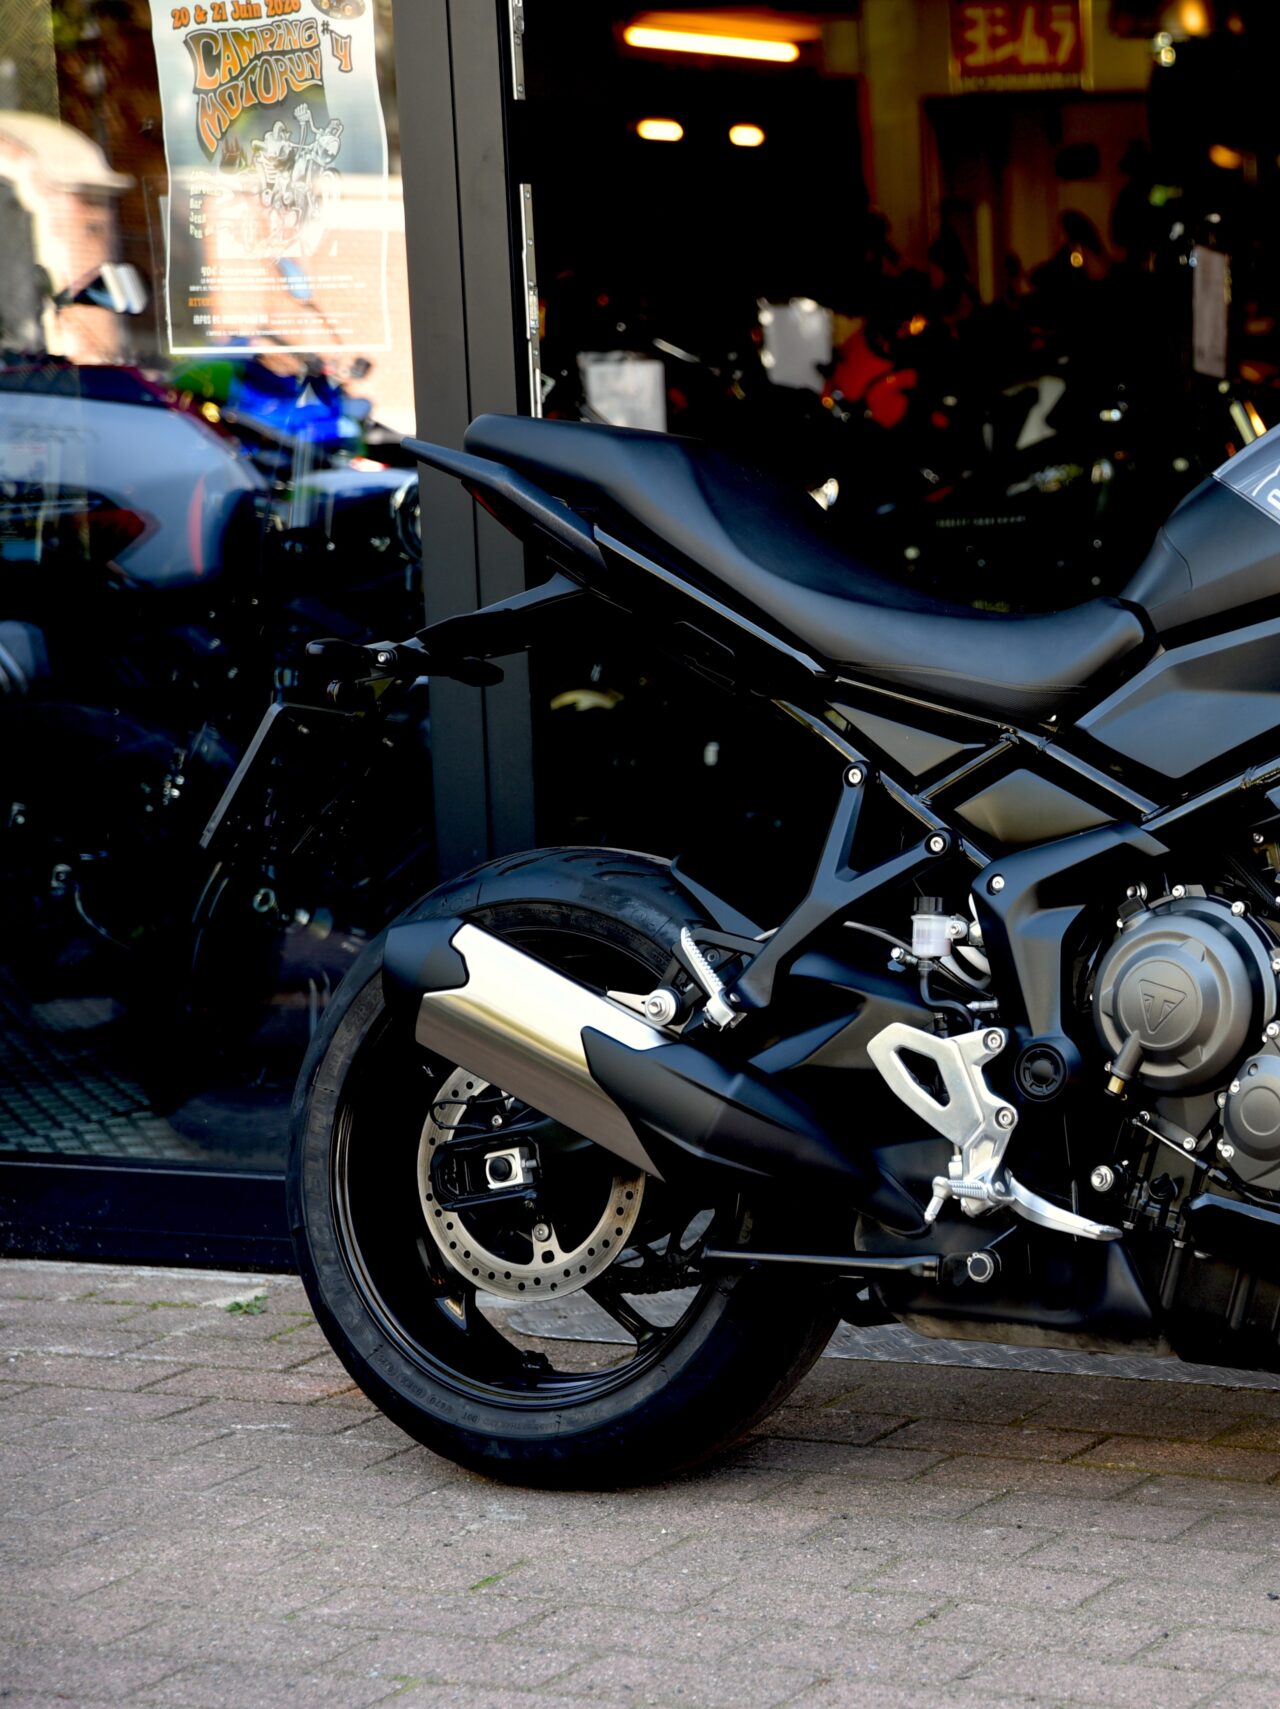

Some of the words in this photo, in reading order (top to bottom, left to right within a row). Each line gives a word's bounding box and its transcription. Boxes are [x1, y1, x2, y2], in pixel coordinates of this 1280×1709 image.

[171, 7, 190, 29] 20
[194, 5, 208, 23] &
[211, 2, 228, 22] 21
[231, 0, 261, 20] Juin
[197, 48, 323, 154] MOTORUN
